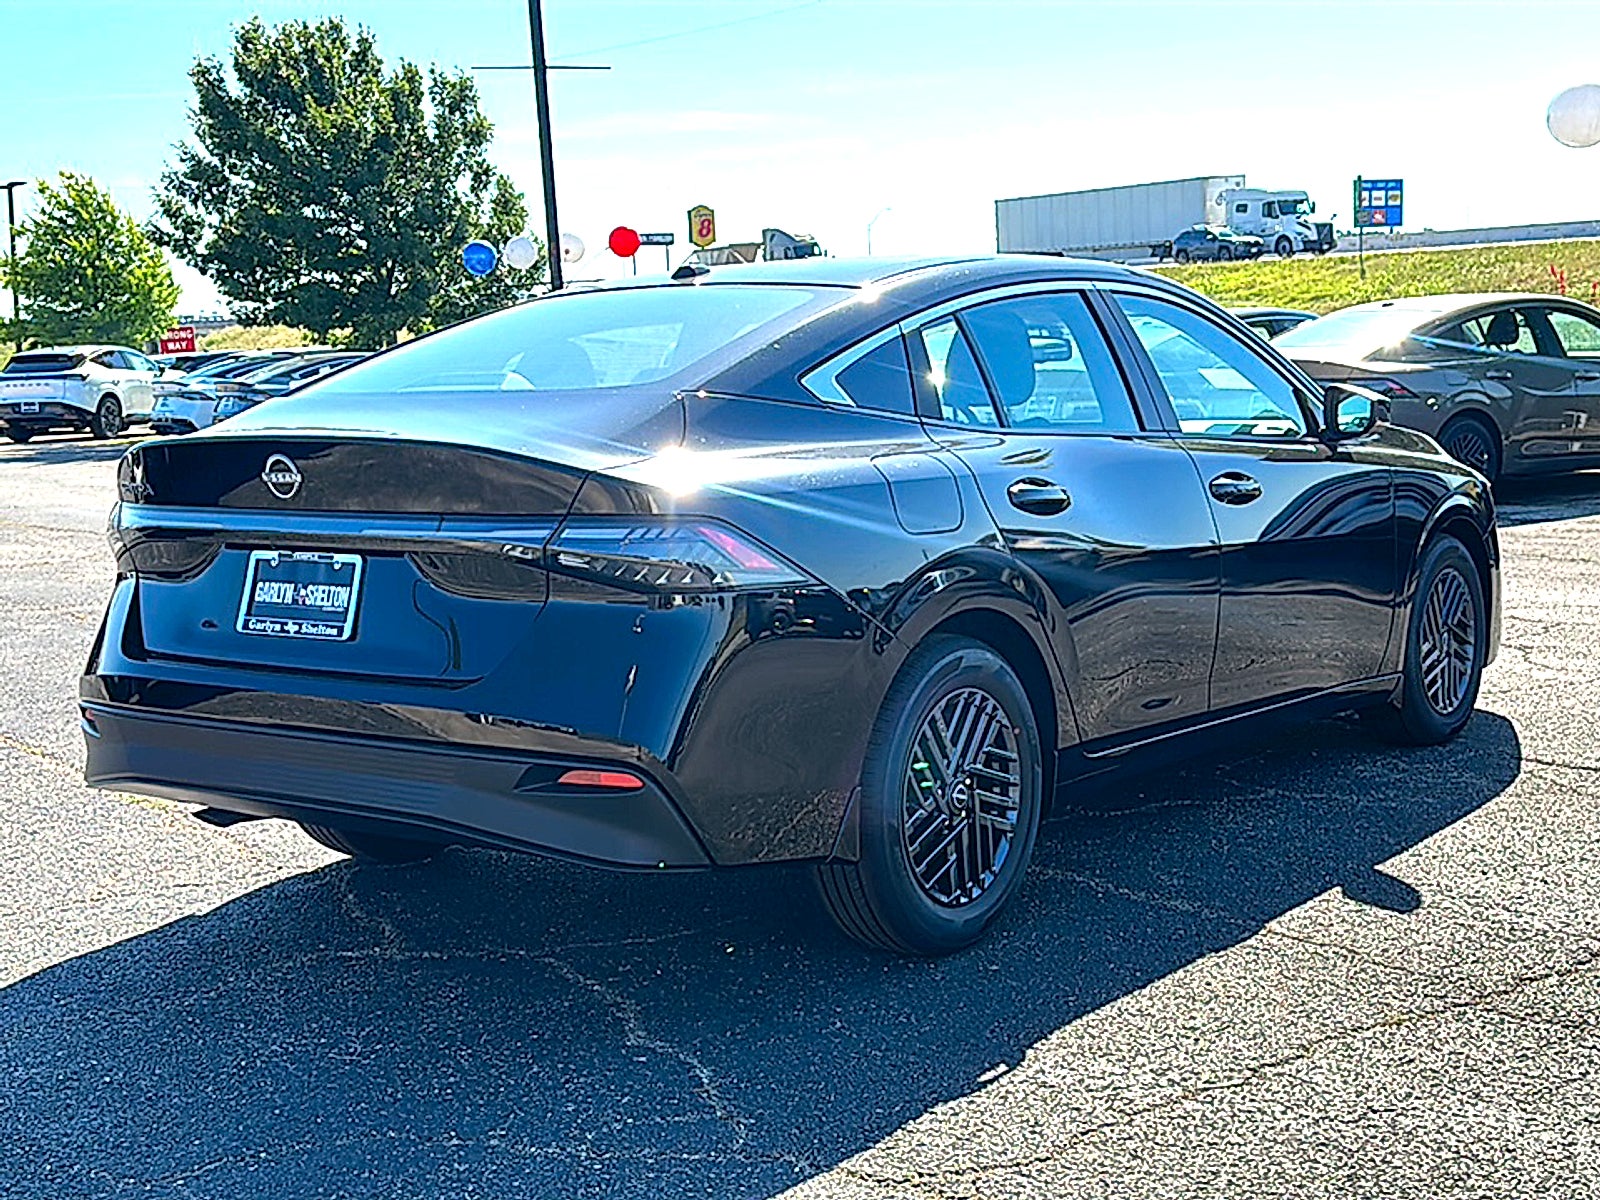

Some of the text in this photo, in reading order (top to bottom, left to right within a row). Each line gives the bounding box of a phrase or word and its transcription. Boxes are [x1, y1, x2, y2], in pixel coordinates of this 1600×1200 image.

[699, 218, 711, 238] 8
[166, 340, 188, 350] WAY
[261, 471, 302, 484] NISSAN
[254, 581, 350, 607] GARLYN SHELTON
[248, 619, 338, 636] Garlyn Shelton
